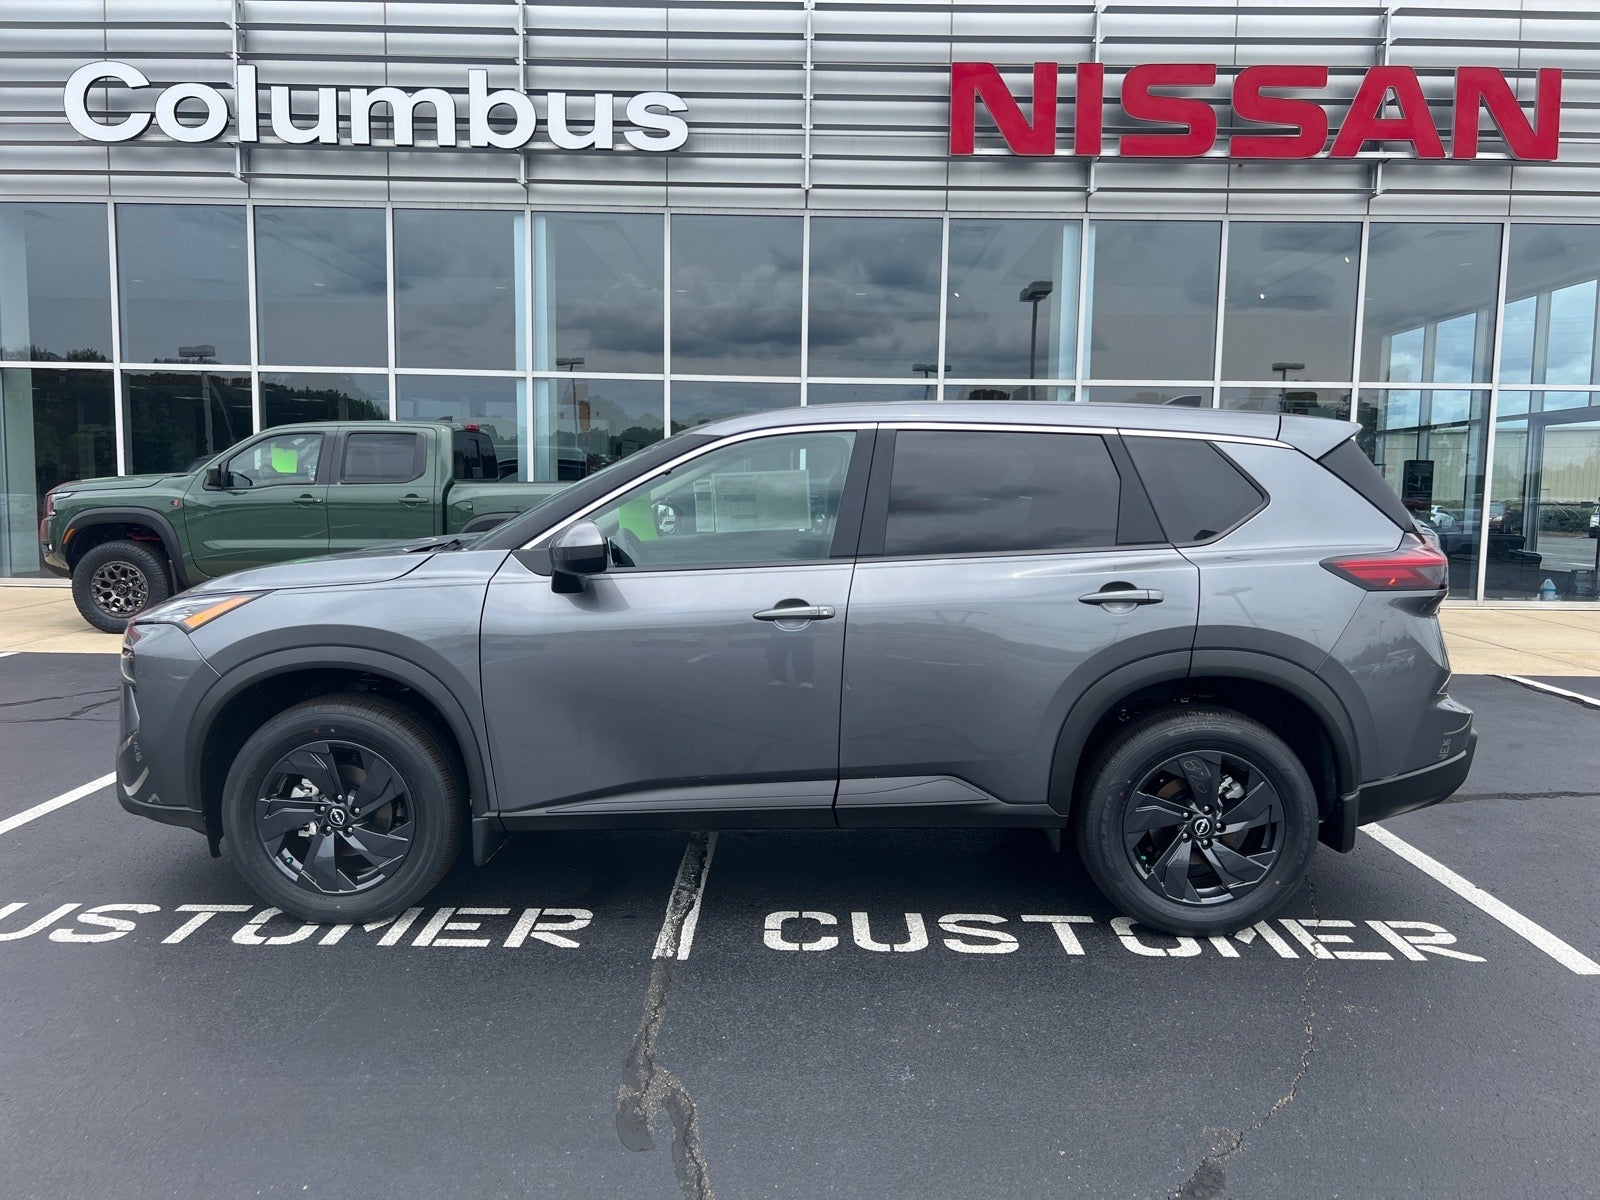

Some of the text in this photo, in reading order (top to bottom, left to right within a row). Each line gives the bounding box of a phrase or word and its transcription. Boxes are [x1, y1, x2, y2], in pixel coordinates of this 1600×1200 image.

[63, 60, 1562, 162] Columbus NISSAN
[763, 910, 1488, 963] CUSTOMER
